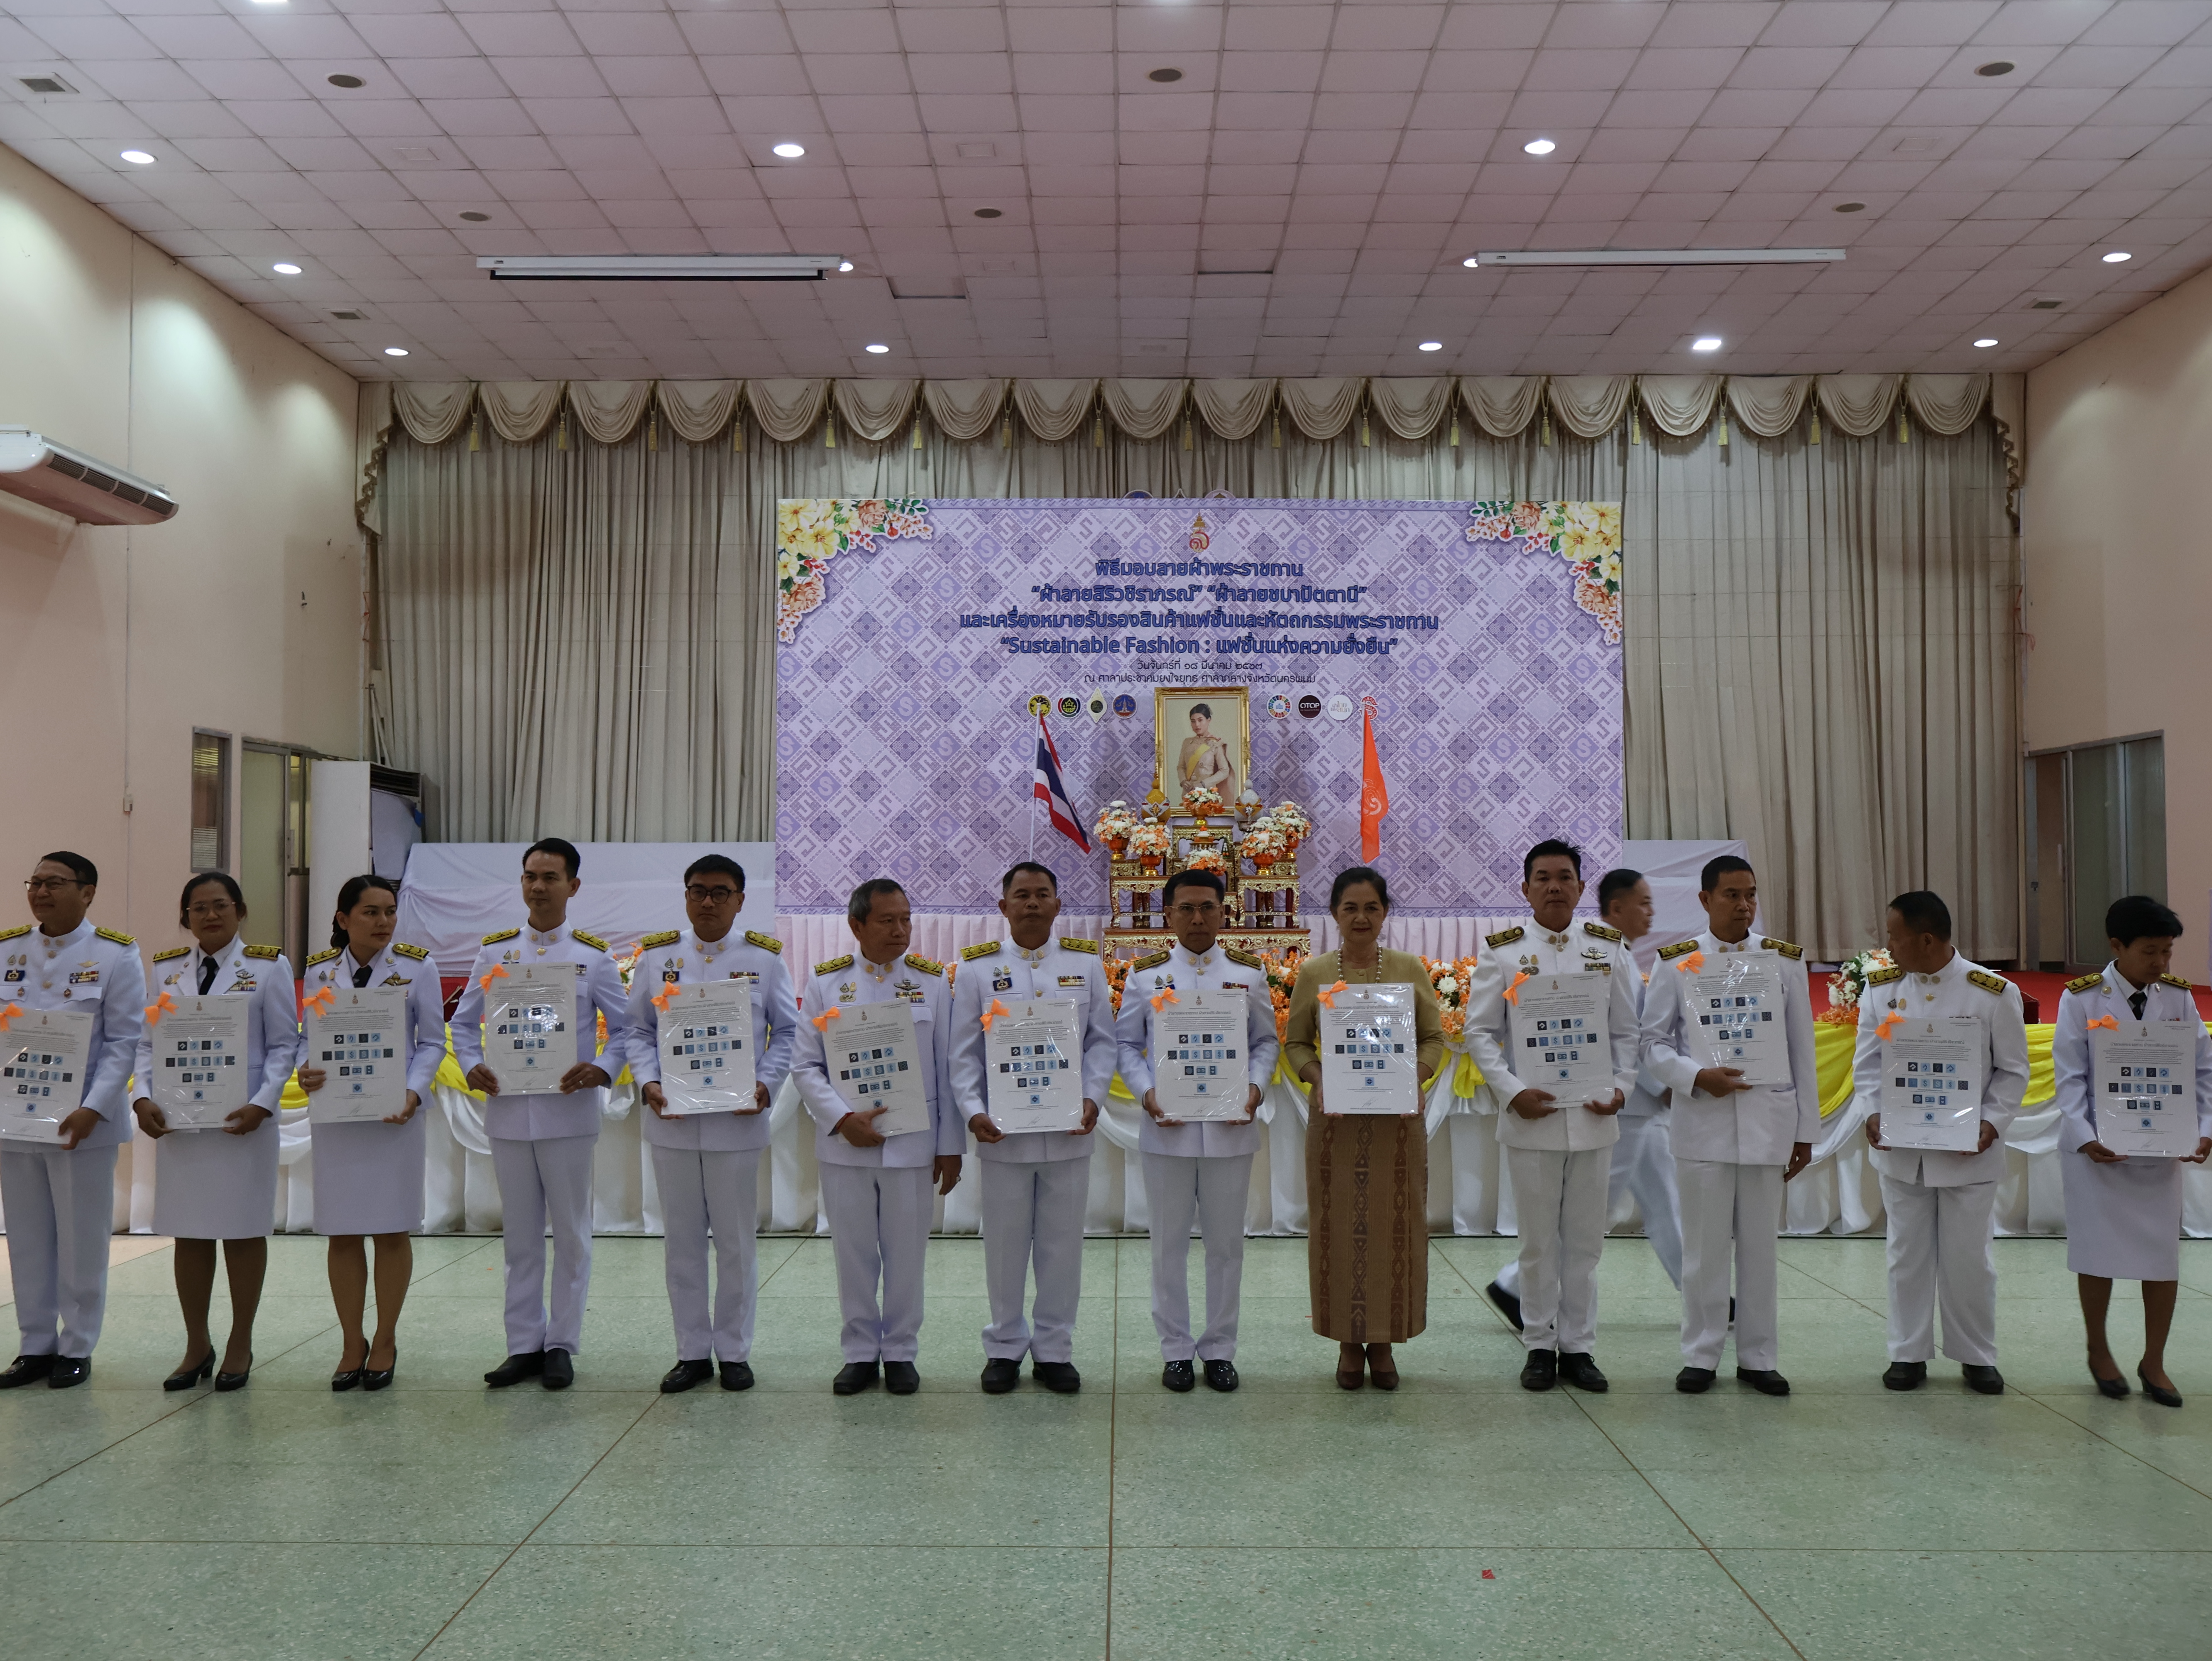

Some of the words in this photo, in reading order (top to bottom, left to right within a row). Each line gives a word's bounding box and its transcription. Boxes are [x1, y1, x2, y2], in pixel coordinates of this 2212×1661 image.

[1096, 557, 1304, 577] พิธีมอบลายผ้าพระราชทาน
[960, 605, 1439, 631] และเครื่องหมายรับรองสินค้าแฟชั่นและหัตถกรรมพระราชทาน
[1126, 636, 1200, 654] Fashion
[1137, 658, 1181, 670] วันจันทร์ที่
[1201, 660, 1232, 670] มีนาคม
[1098, 673, 1198, 684] ศาลาประชาคมยงใจยุทธ
[1201, 674, 1316, 683] ศาลากลางจังหวัดนครพนม
